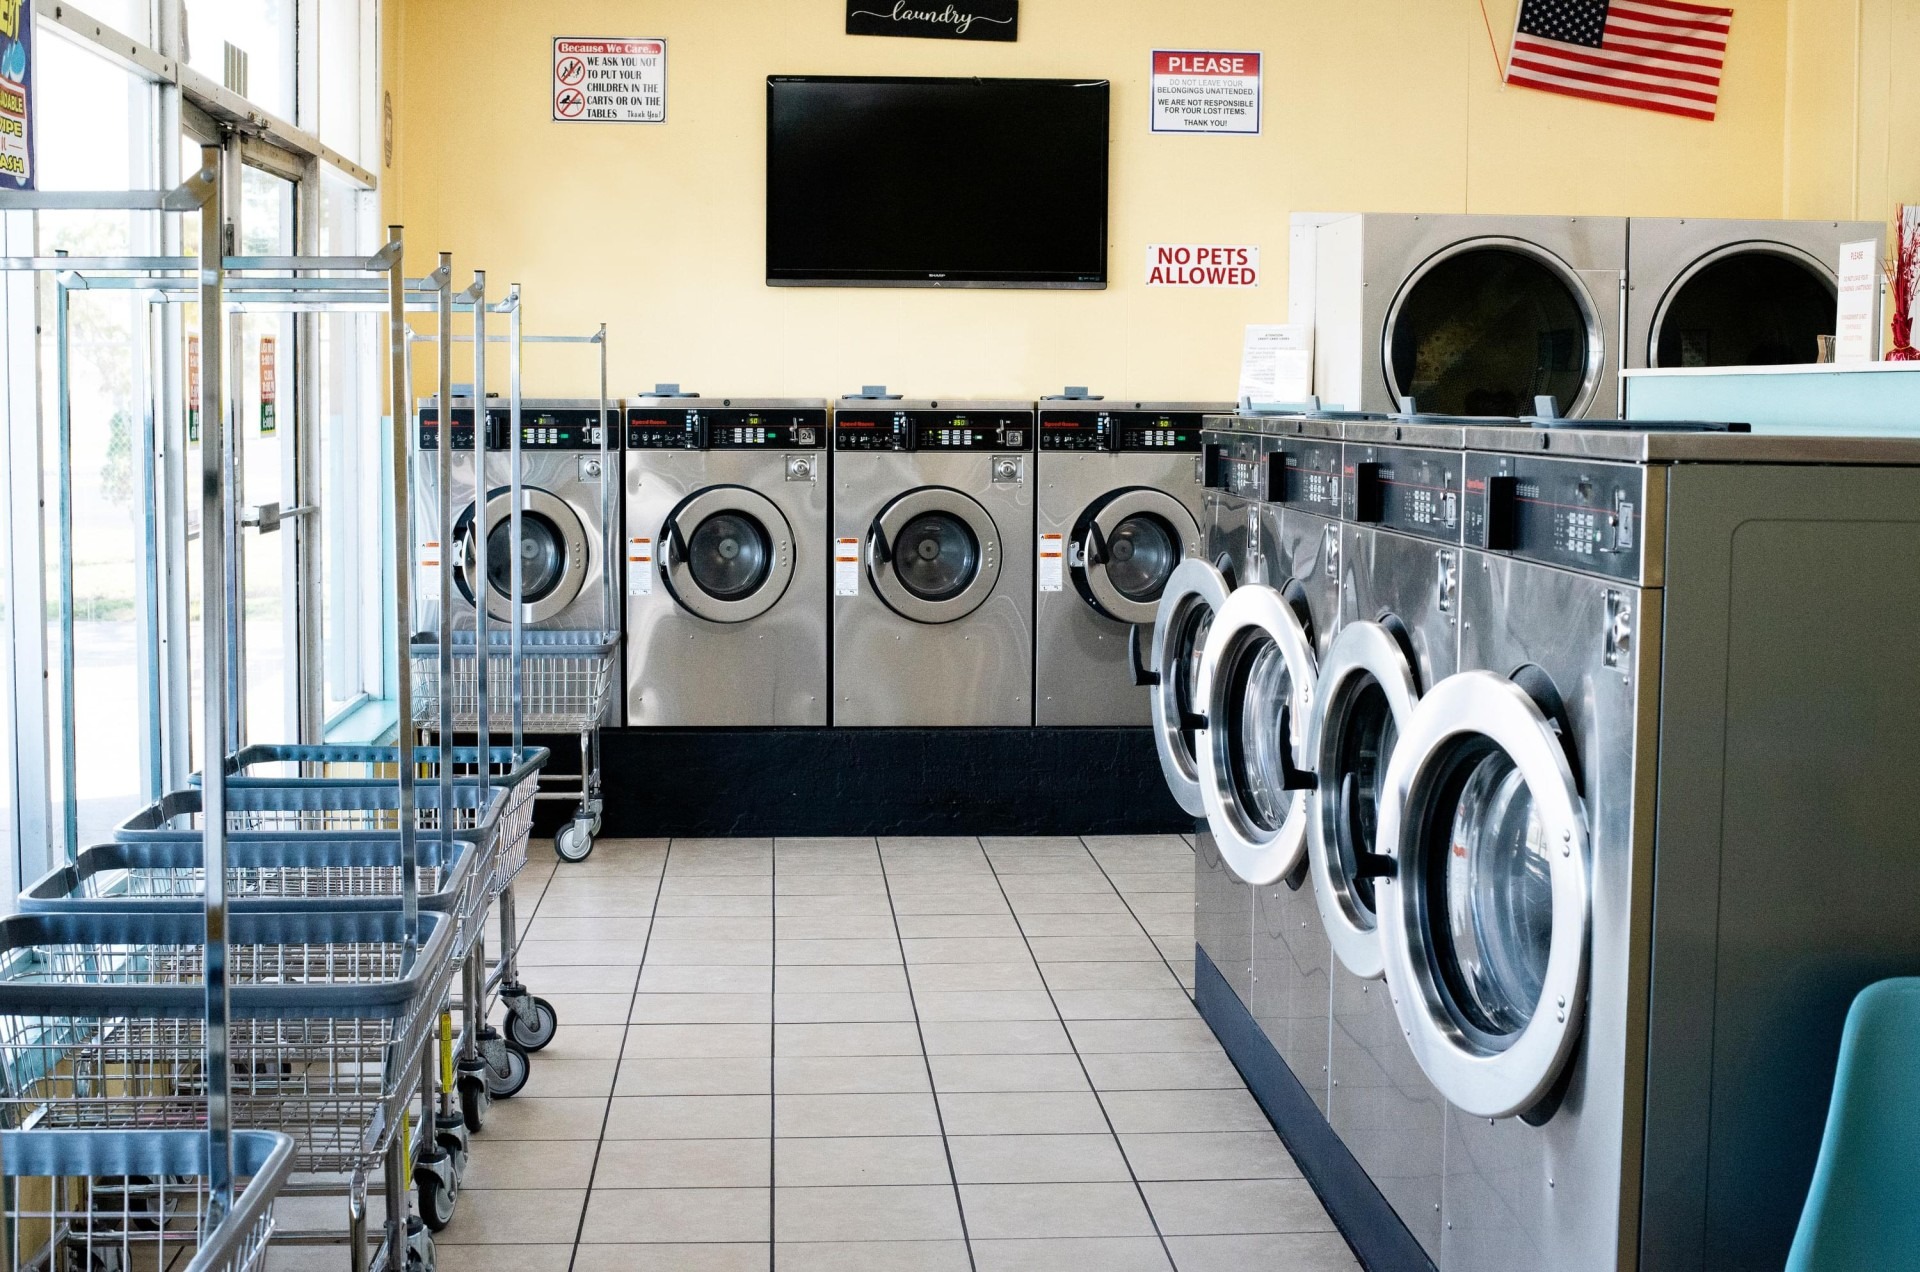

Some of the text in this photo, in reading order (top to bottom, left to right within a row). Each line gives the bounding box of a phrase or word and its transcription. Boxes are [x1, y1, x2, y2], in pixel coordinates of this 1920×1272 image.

[892, 0, 973, 34] laundry
[561, 44, 603, 53] Because
[607, 44, 621, 52] We
[587, 57, 656, 66] WE ASK YOU NOT
[1169, 57, 1244, 73] PLEASE
[587, 70, 641, 79] TO PUT YOUR
[587, 83, 658, 93] CHILDREN IN THE
[587, 96, 660, 106] CARTS OR ON THE
[587, 109, 617, 118] TABLES
[647, 111, 661, 119] You!
[1159, 248, 1248, 265] NO PETS
[1150, 267, 1255, 284] ALLOWED
